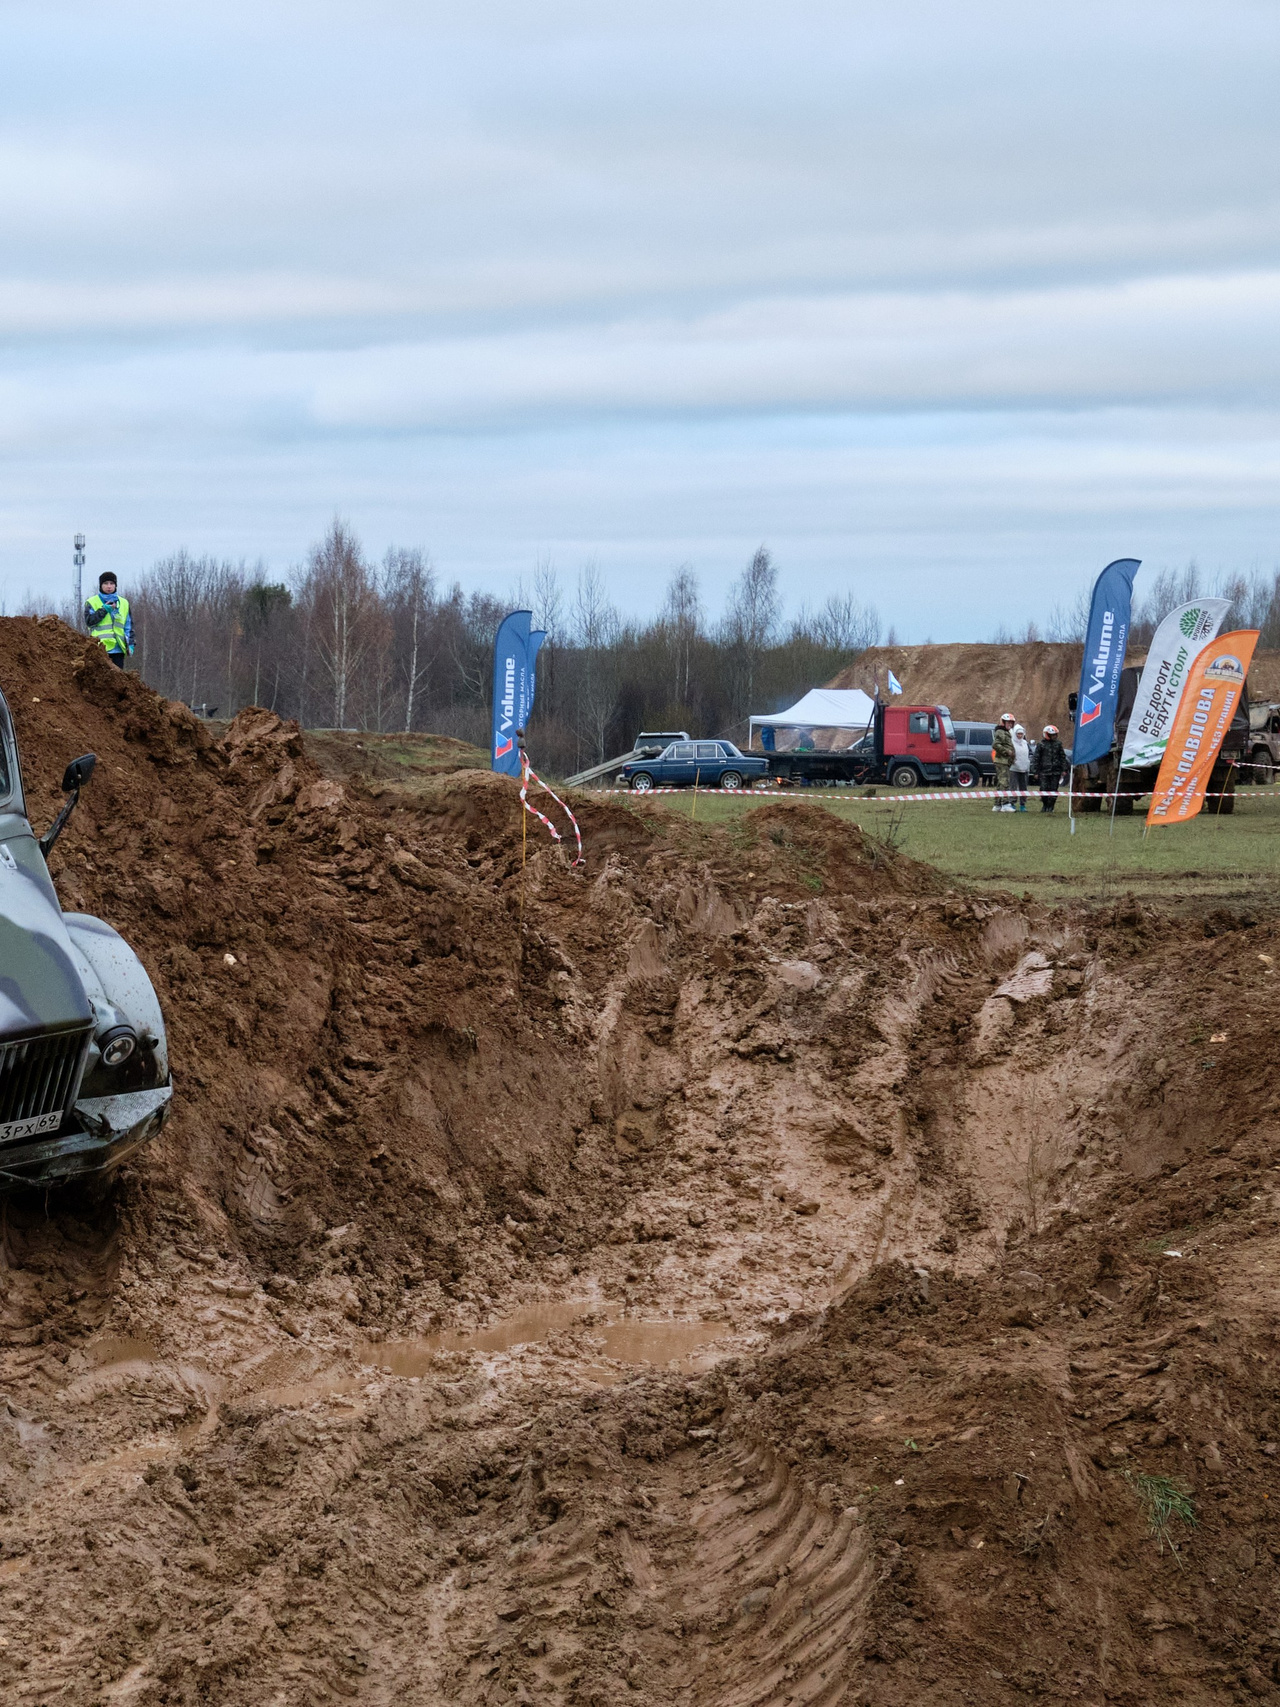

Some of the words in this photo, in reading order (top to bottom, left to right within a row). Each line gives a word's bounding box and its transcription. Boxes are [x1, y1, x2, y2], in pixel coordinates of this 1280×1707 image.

[1088, 610, 1115, 695] Volume
[1109, 653, 1122, 697] МОТОРНЫЕ
[1117, 623, 1126, 652] МАСЛА
[1169, 646, 1189, 688] СТОЛУ
[500, 657, 515, 731] Volume
[1138, 709, 1156, 734] ВСЕ
[1149, 660, 1172, 712] ДОРОГИ
[1165, 688, 1177, 699] К
[1216, 690, 1237, 729] ГРАНИЦ
[1150, 697, 1172, 738] ВЕДУТ
[1177, 687, 1217, 773] ПАВЛОВА
[1210, 730, 1223, 749] БЕЗ
[39, 1114, 56, 1127] 69
